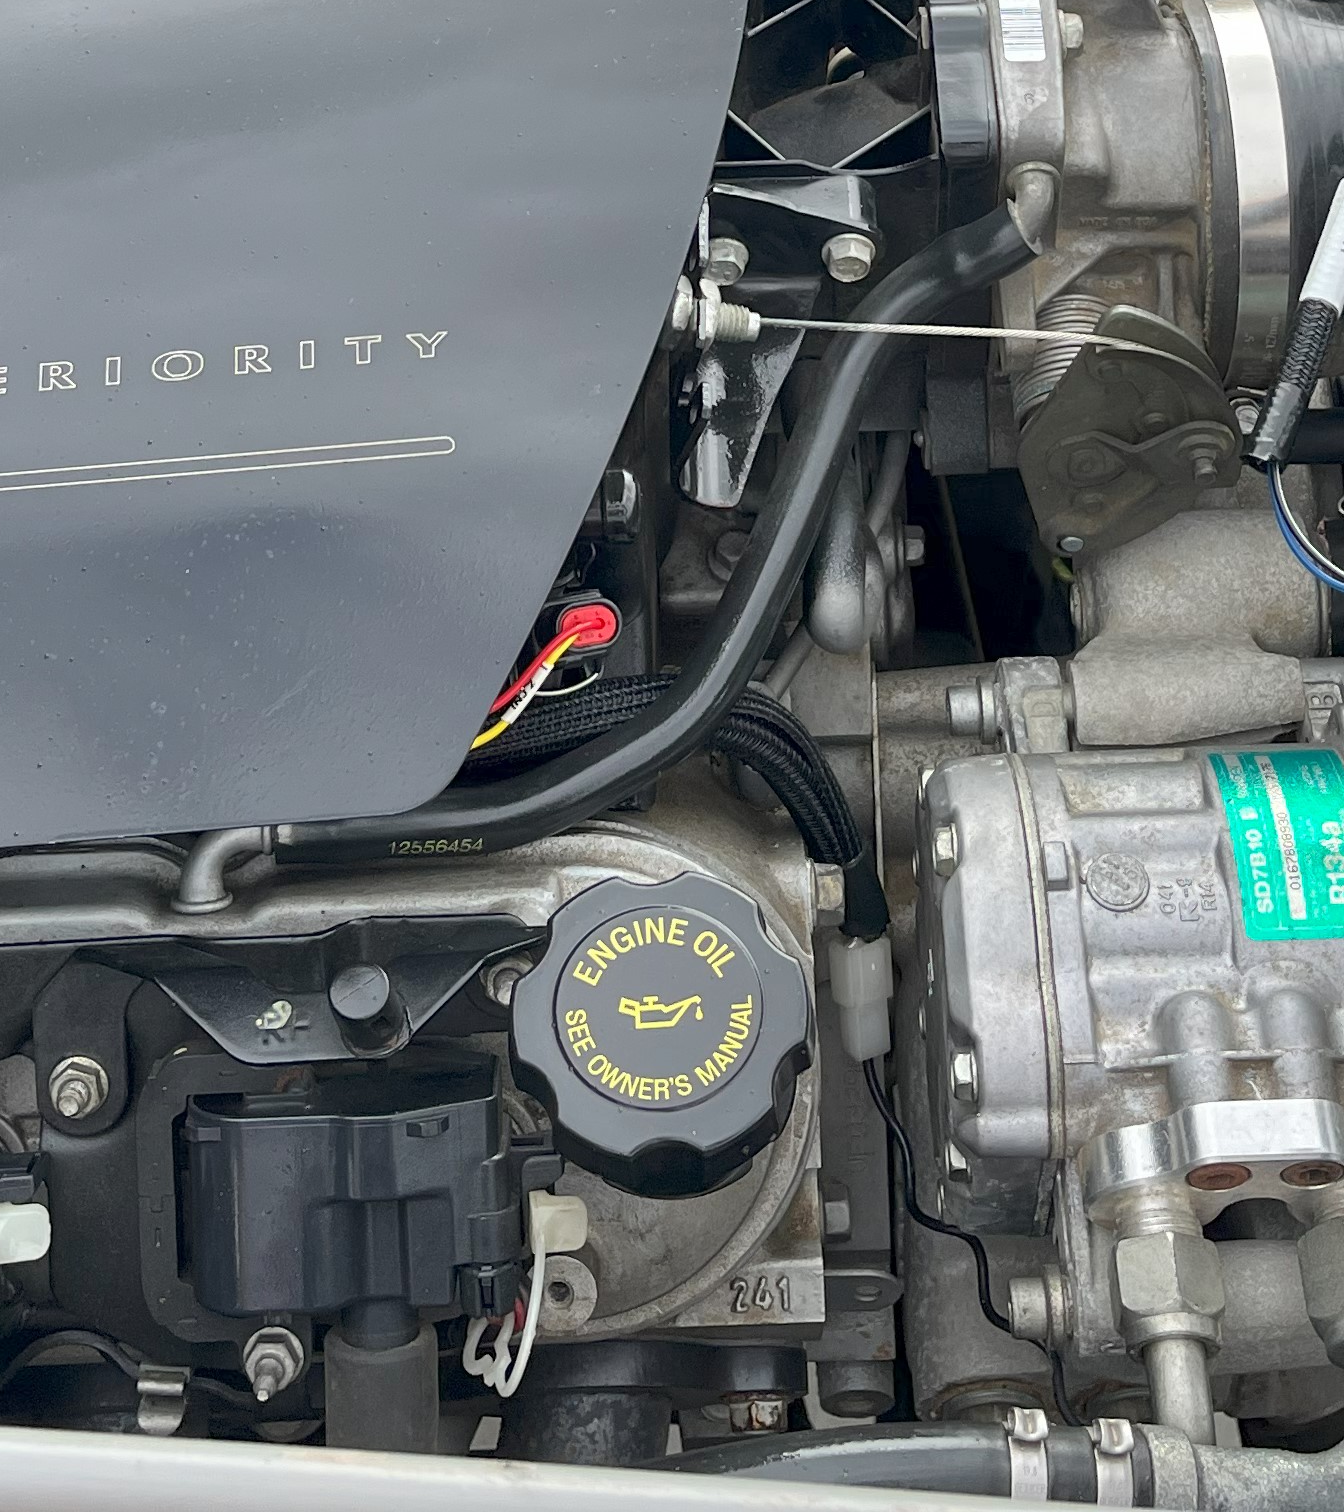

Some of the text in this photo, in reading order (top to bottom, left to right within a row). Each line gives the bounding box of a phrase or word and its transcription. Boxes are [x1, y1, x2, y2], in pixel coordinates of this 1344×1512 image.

[388, 837, 484, 856] 12556454
[572, 916, 736, 987] ENGINE OIL
[564, 994, 753, 1101] SEE OWNER'S MANUAL
[729, 1275, 791, 1314] 241
